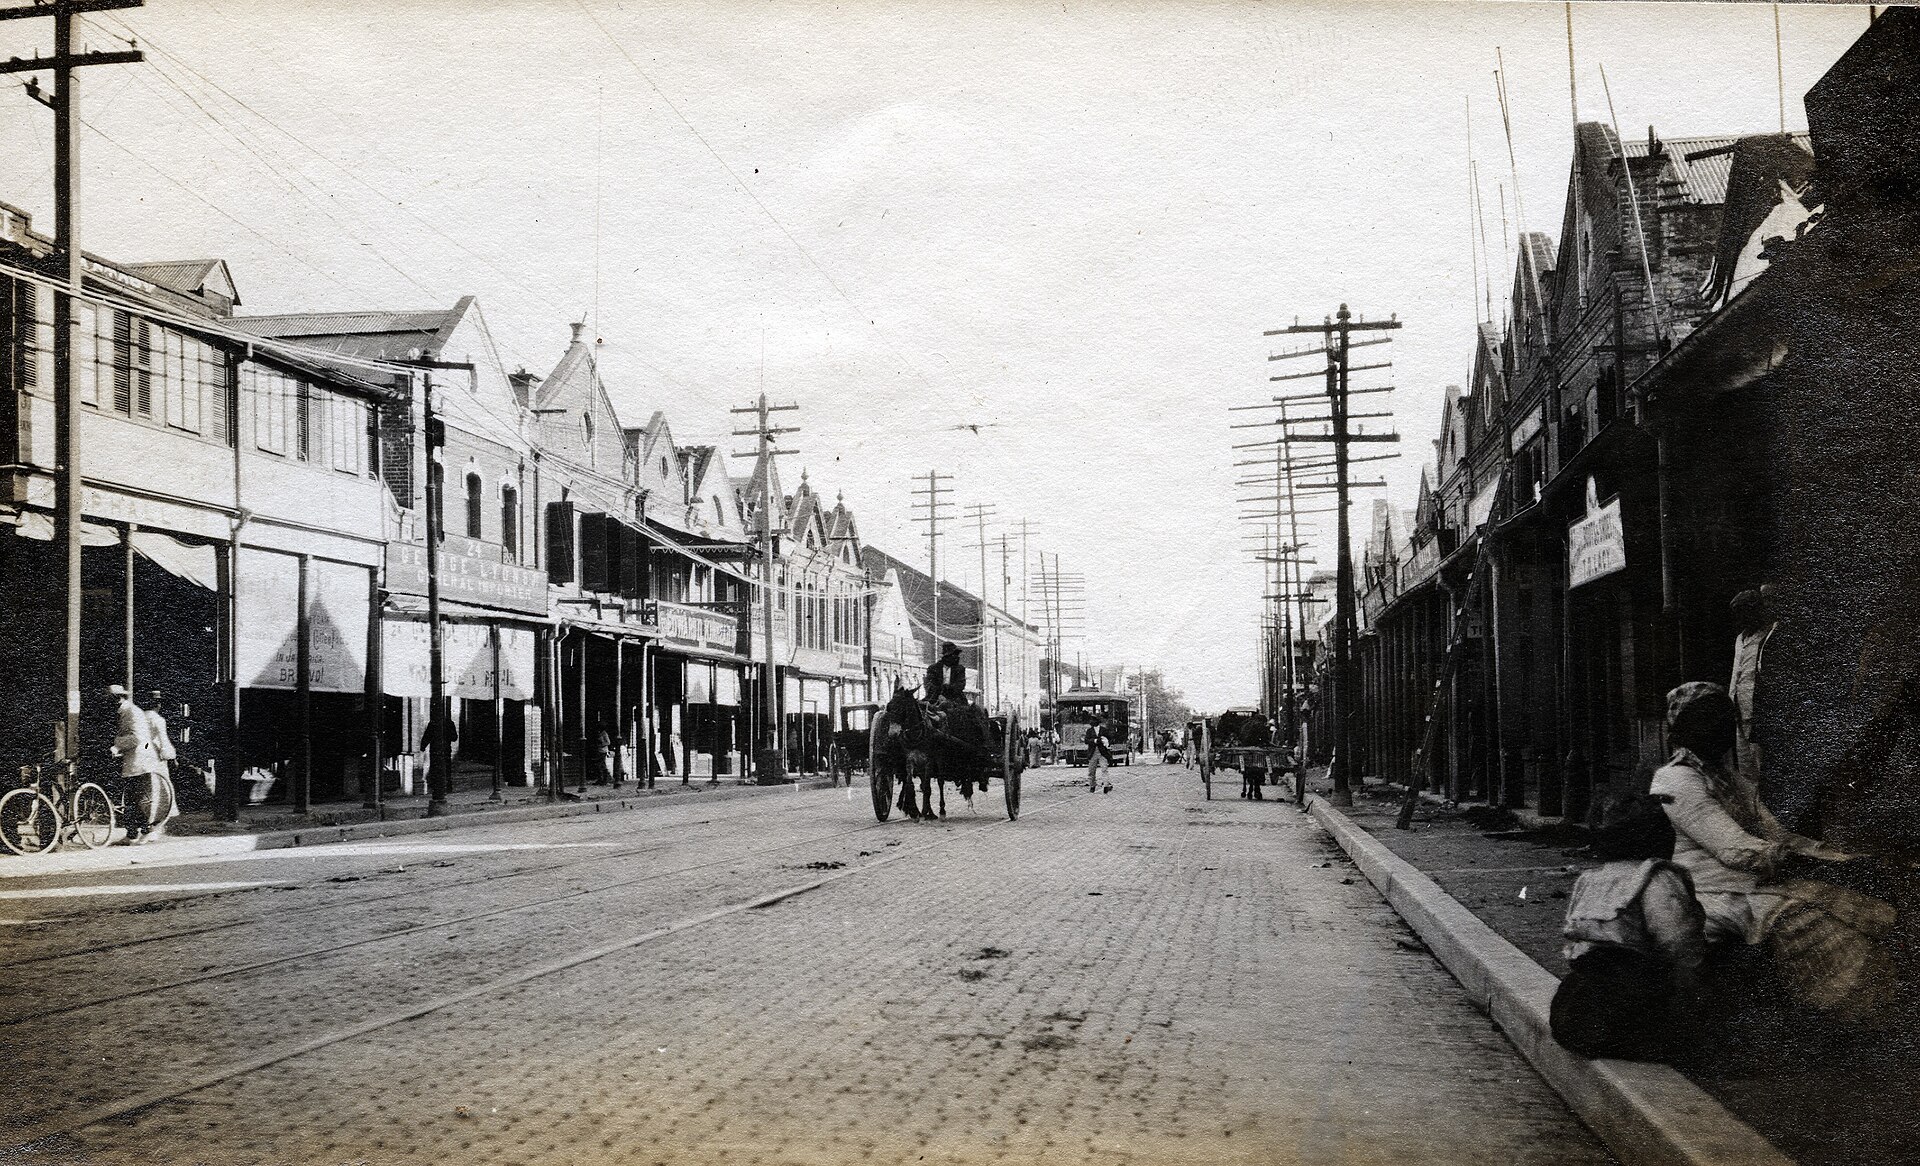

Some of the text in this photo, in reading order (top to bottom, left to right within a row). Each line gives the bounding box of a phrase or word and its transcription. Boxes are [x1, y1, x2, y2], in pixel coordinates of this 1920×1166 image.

[401, 546, 468, 574] GERGE
[417, 569, 474, 591] GERAL
[285, 647, 324, 663] JAICA.
[279, 667, 323, 683] BRVO!
